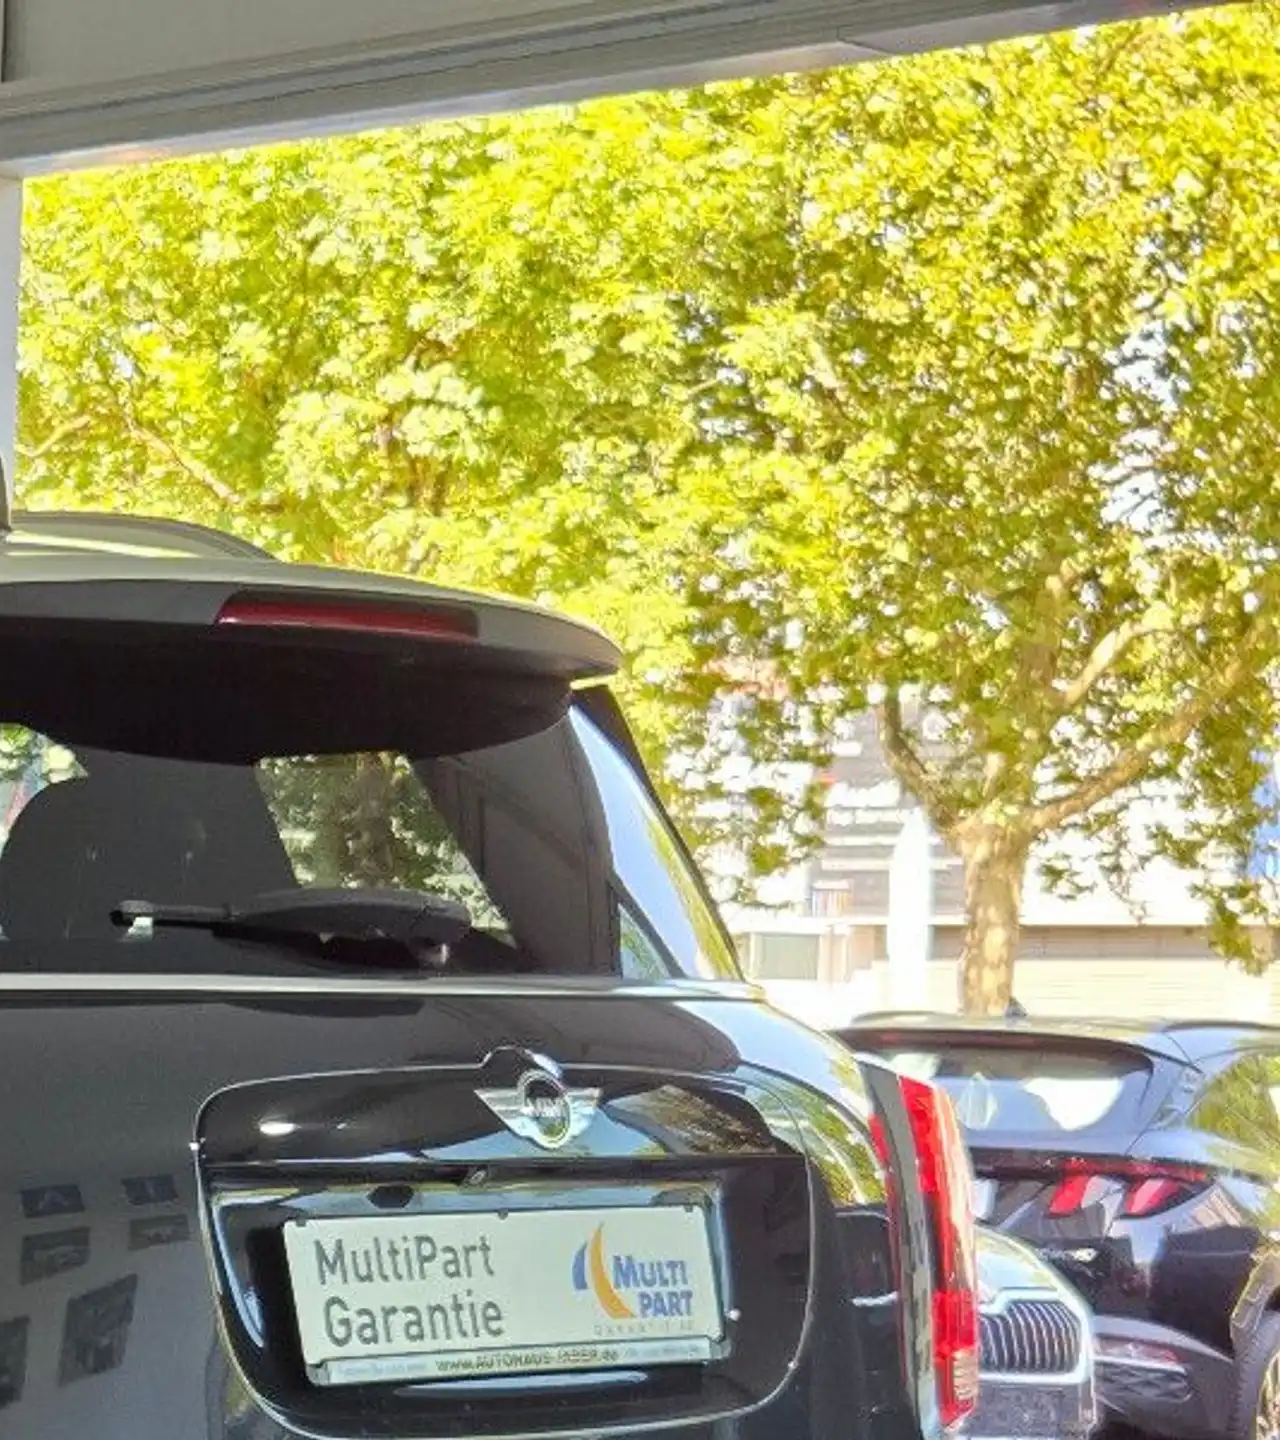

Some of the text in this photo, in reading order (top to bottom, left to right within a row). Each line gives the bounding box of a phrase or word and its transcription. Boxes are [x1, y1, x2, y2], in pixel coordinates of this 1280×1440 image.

[313, 1235, 495, 1286] MultiPart
[323, 1289, 505, 1348] Garantie
[636, 1289, 694, 1319] PART
